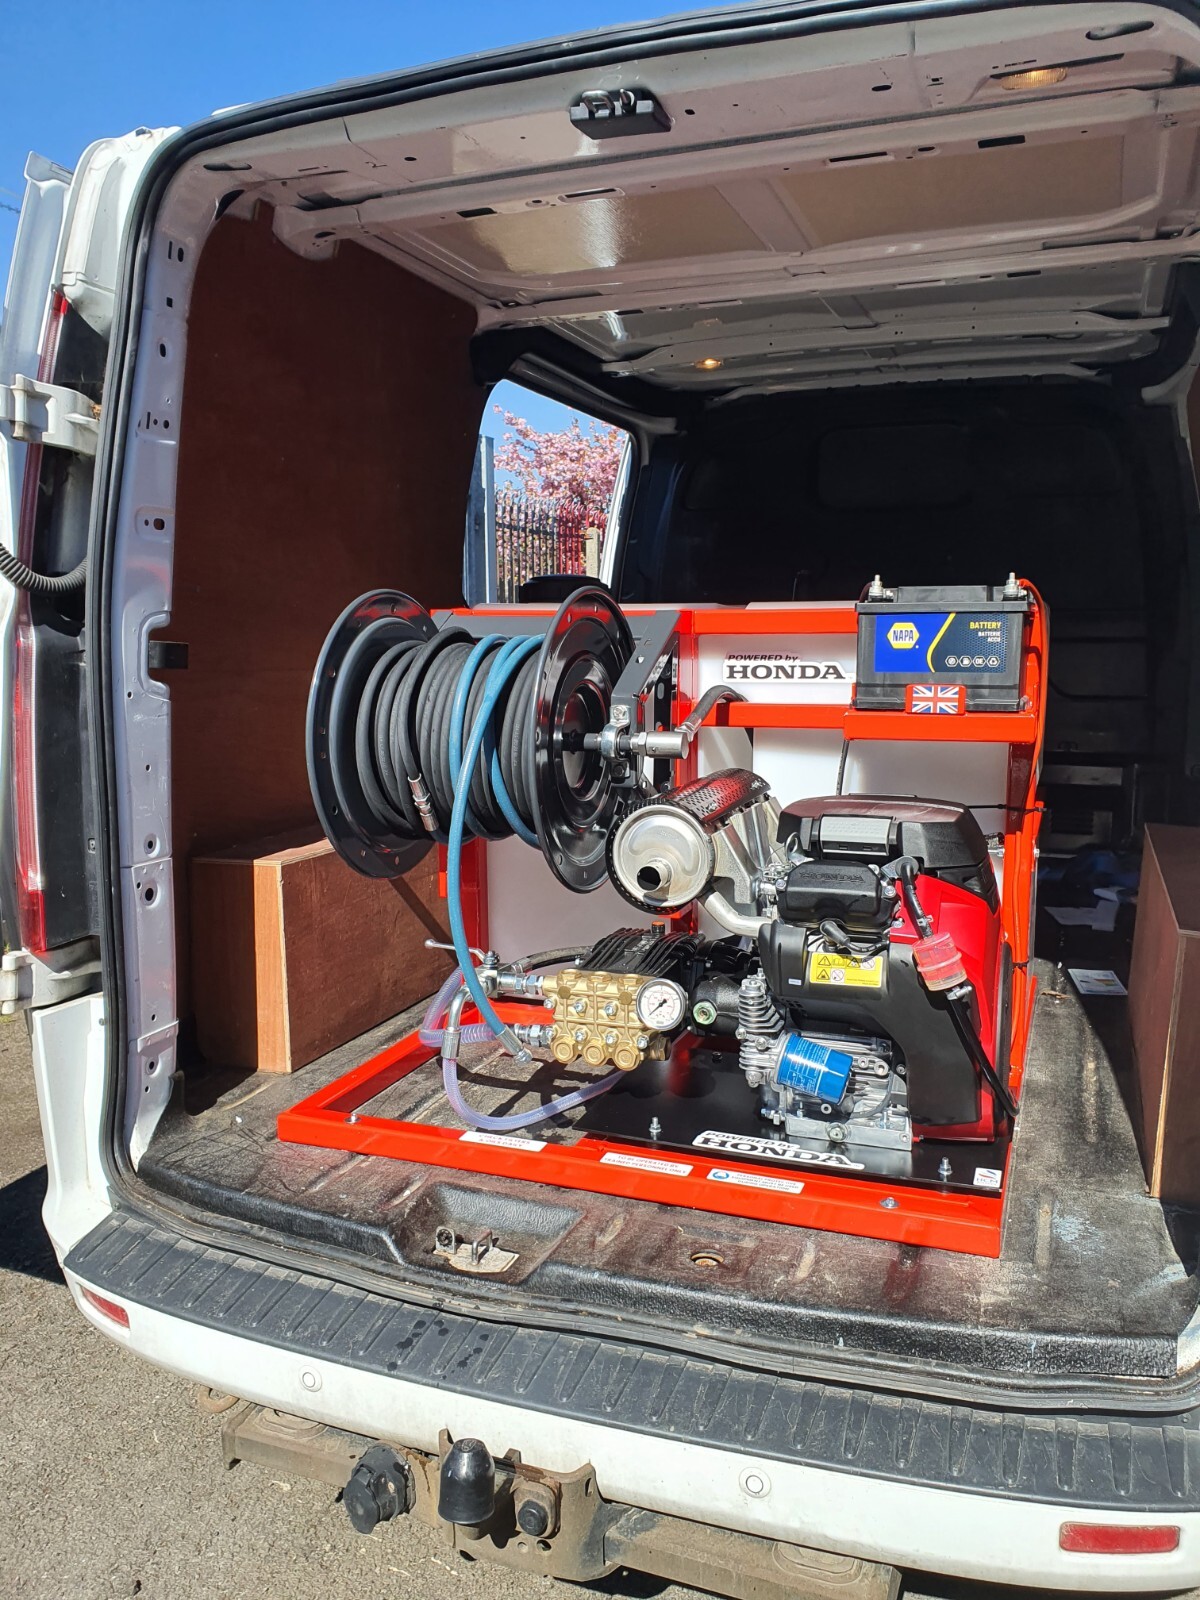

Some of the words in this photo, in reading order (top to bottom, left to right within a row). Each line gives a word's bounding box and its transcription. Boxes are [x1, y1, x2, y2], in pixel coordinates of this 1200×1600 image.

[969, 621, 1002, 630] BATTERY
[892, 629, 914, 642] NAPA
[728, 654, 783, 662] POWERED
[785, 654, 799, 663] by
[726, 664, 846, 680] HONDA
[705, 1132, 775, 1146] POWERED
[699, 1137, 852, 1167] HONDA
